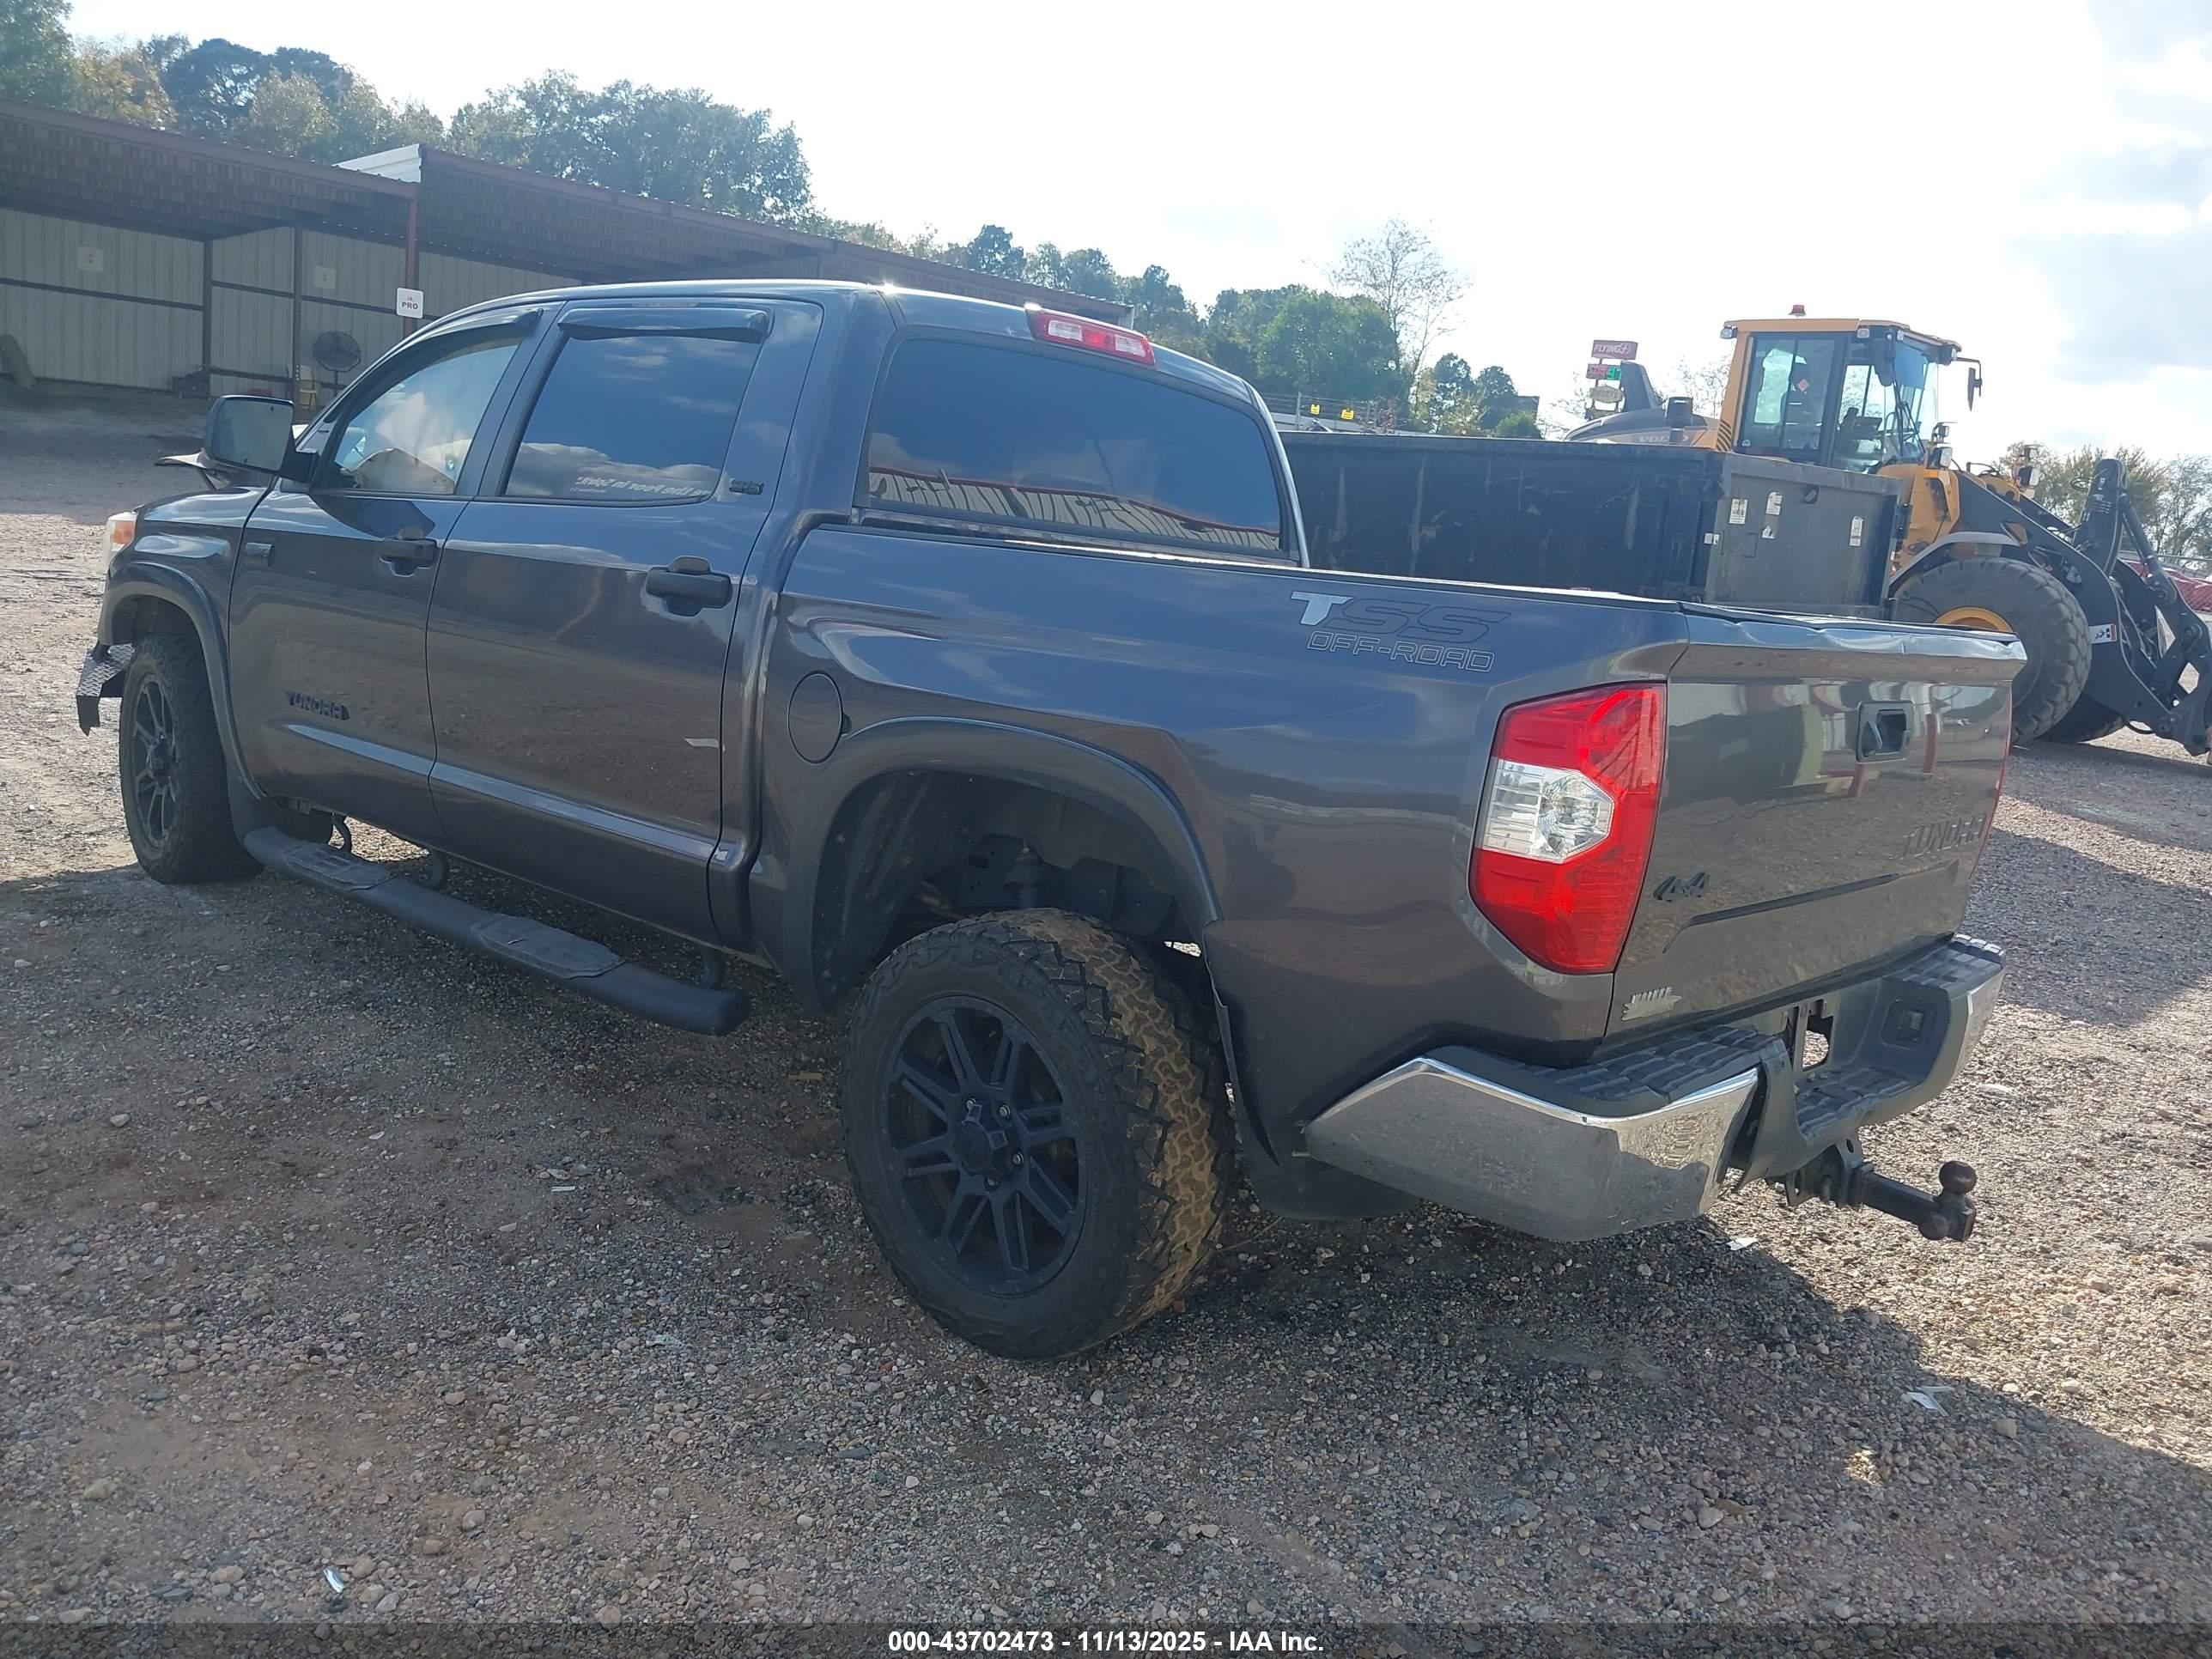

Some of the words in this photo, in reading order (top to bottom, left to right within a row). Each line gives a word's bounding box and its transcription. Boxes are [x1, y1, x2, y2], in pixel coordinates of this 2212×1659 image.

[401, 301, 419, 310] PRO
[1593, 344, 1620, 354] FLYING
[1638, 434, 1690, 444] VOLO
[1306, 630, 1496, 673] OFF-ROAD
[286, 691, 350, 721] TUNDRA
